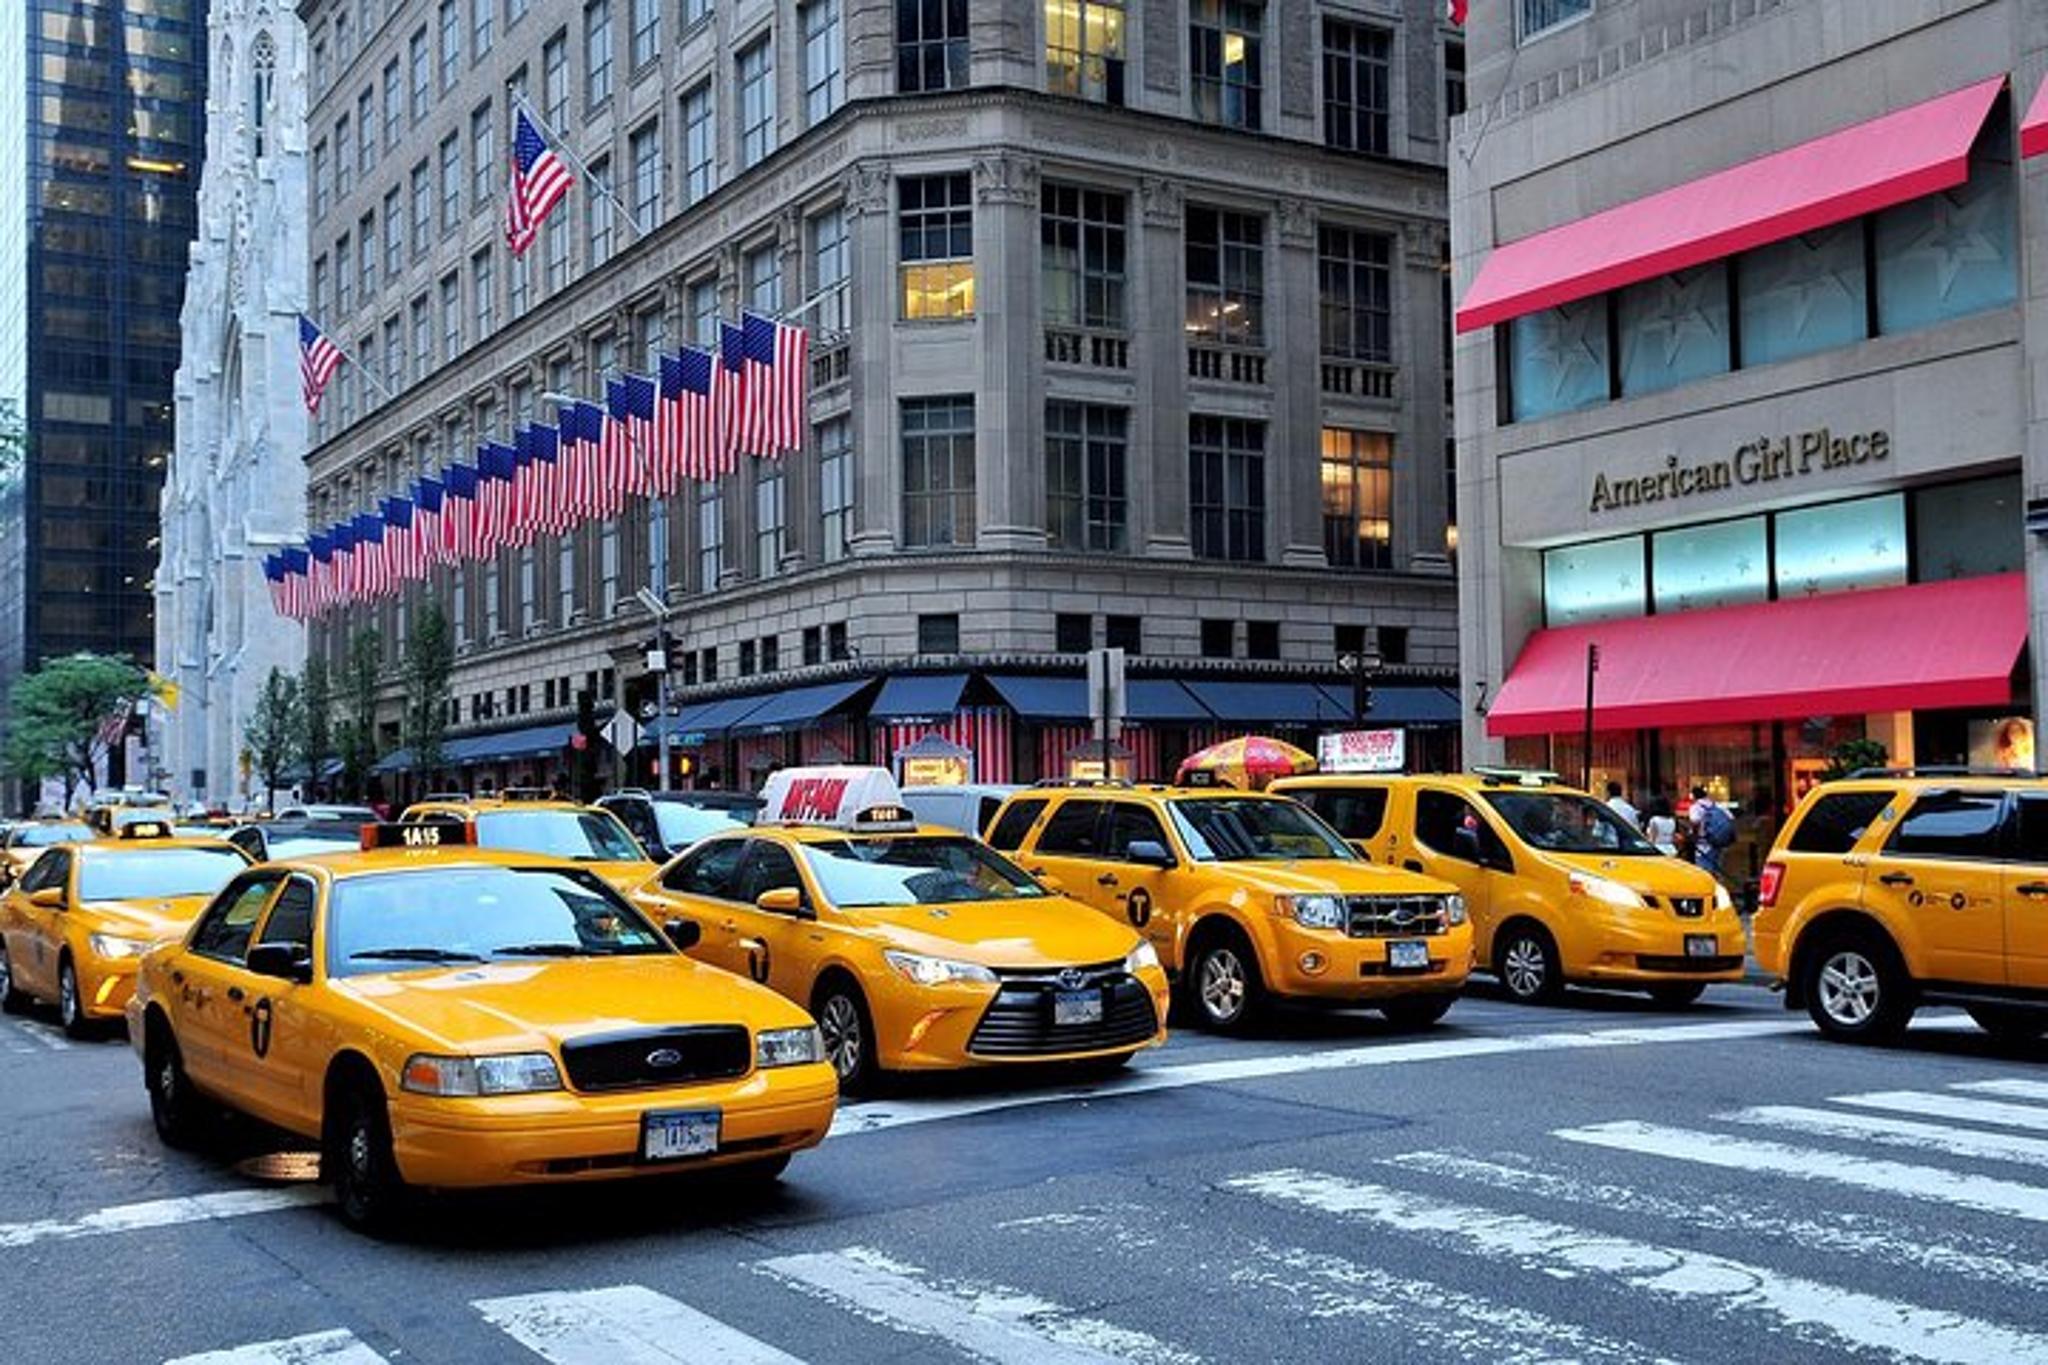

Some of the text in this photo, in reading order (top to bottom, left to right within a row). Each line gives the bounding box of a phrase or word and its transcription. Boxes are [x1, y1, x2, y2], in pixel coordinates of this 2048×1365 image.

[1590, 427, 1890, 512] American Girl Place
